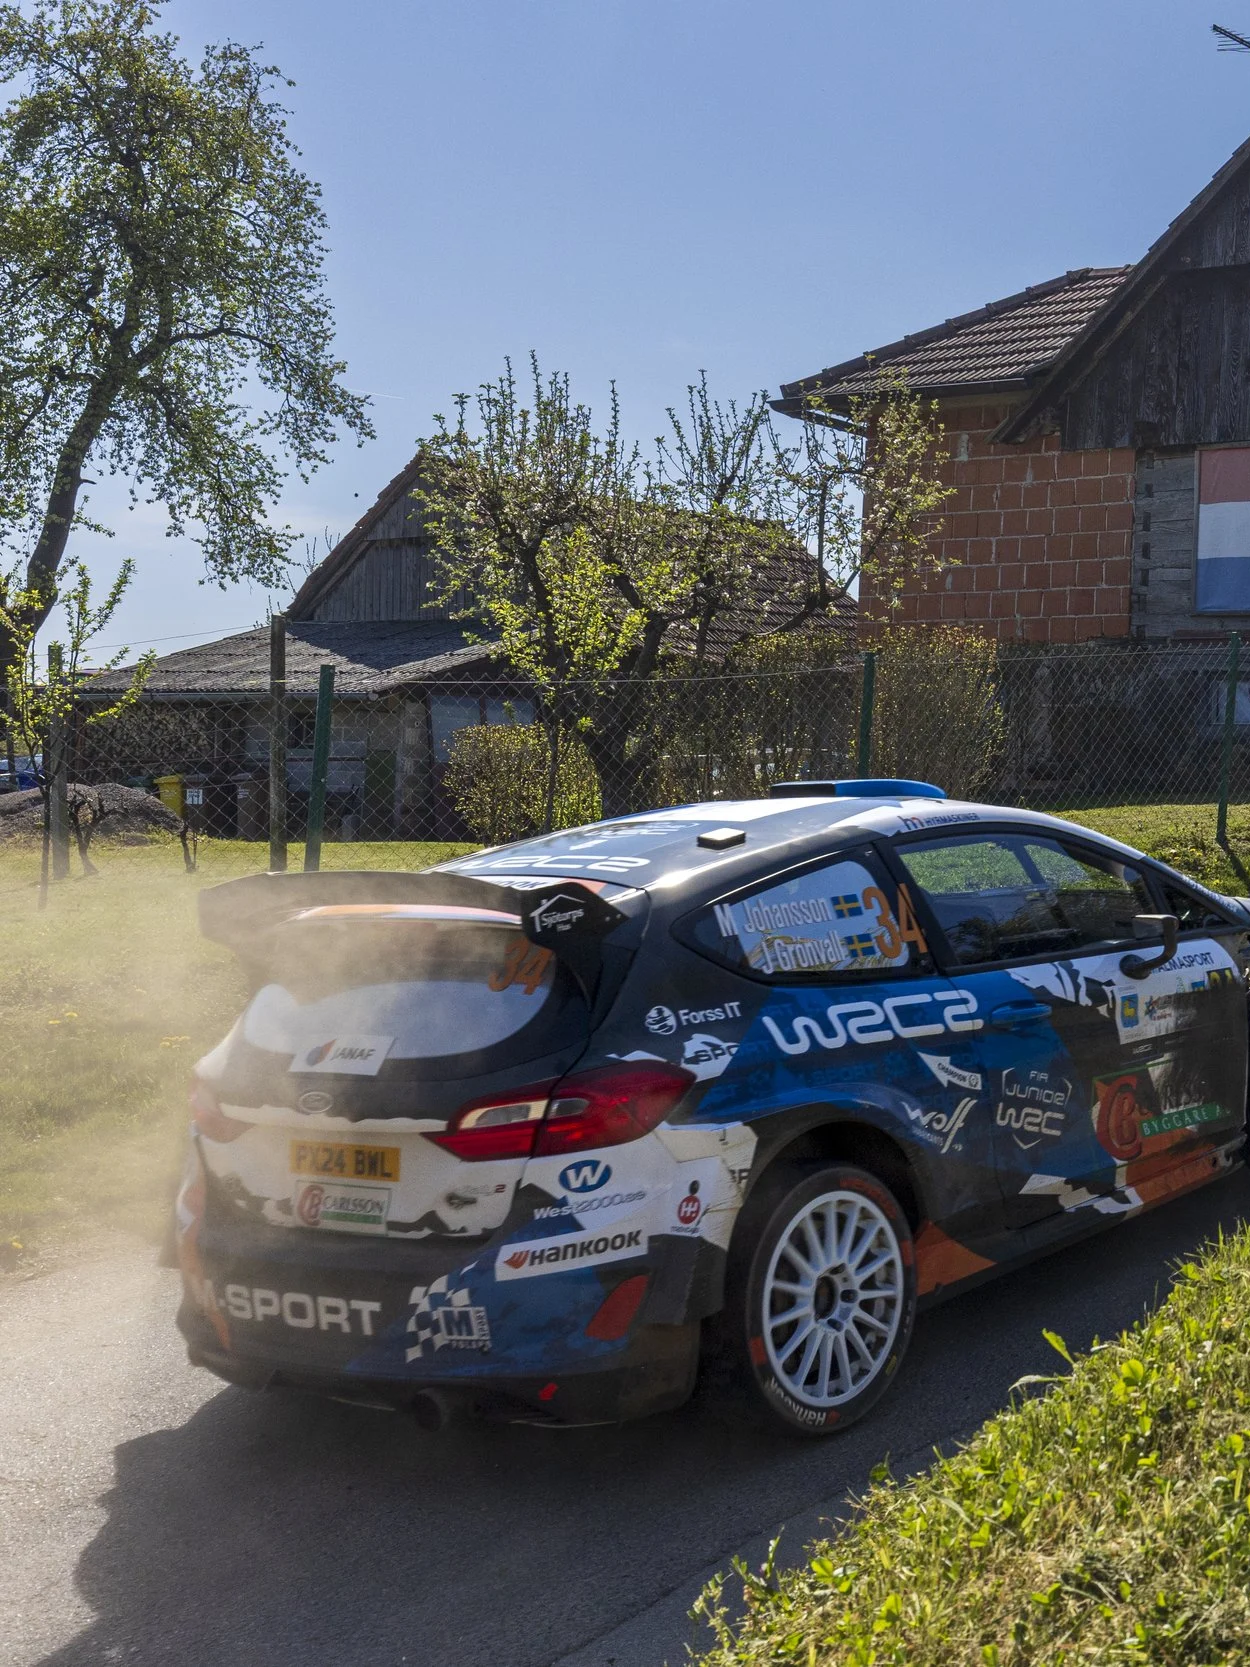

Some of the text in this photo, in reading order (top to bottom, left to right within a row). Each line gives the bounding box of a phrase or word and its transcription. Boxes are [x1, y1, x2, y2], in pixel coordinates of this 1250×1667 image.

[713, 897, 833, 938] M Johansson
[862, 882, 928, 960] 34
[761, 940, 775, 975] J
[679, 1006, 723, 1027] Forss
[724, 1001, 742, 1019] IT
[762, 989, 984, 1055] WRC2
[1029, 1070, 1049, 1083] FIA
[996, 1102, 1066, 1137] WRC
[1141, 1107, 1210, 1136] BYGGARE
